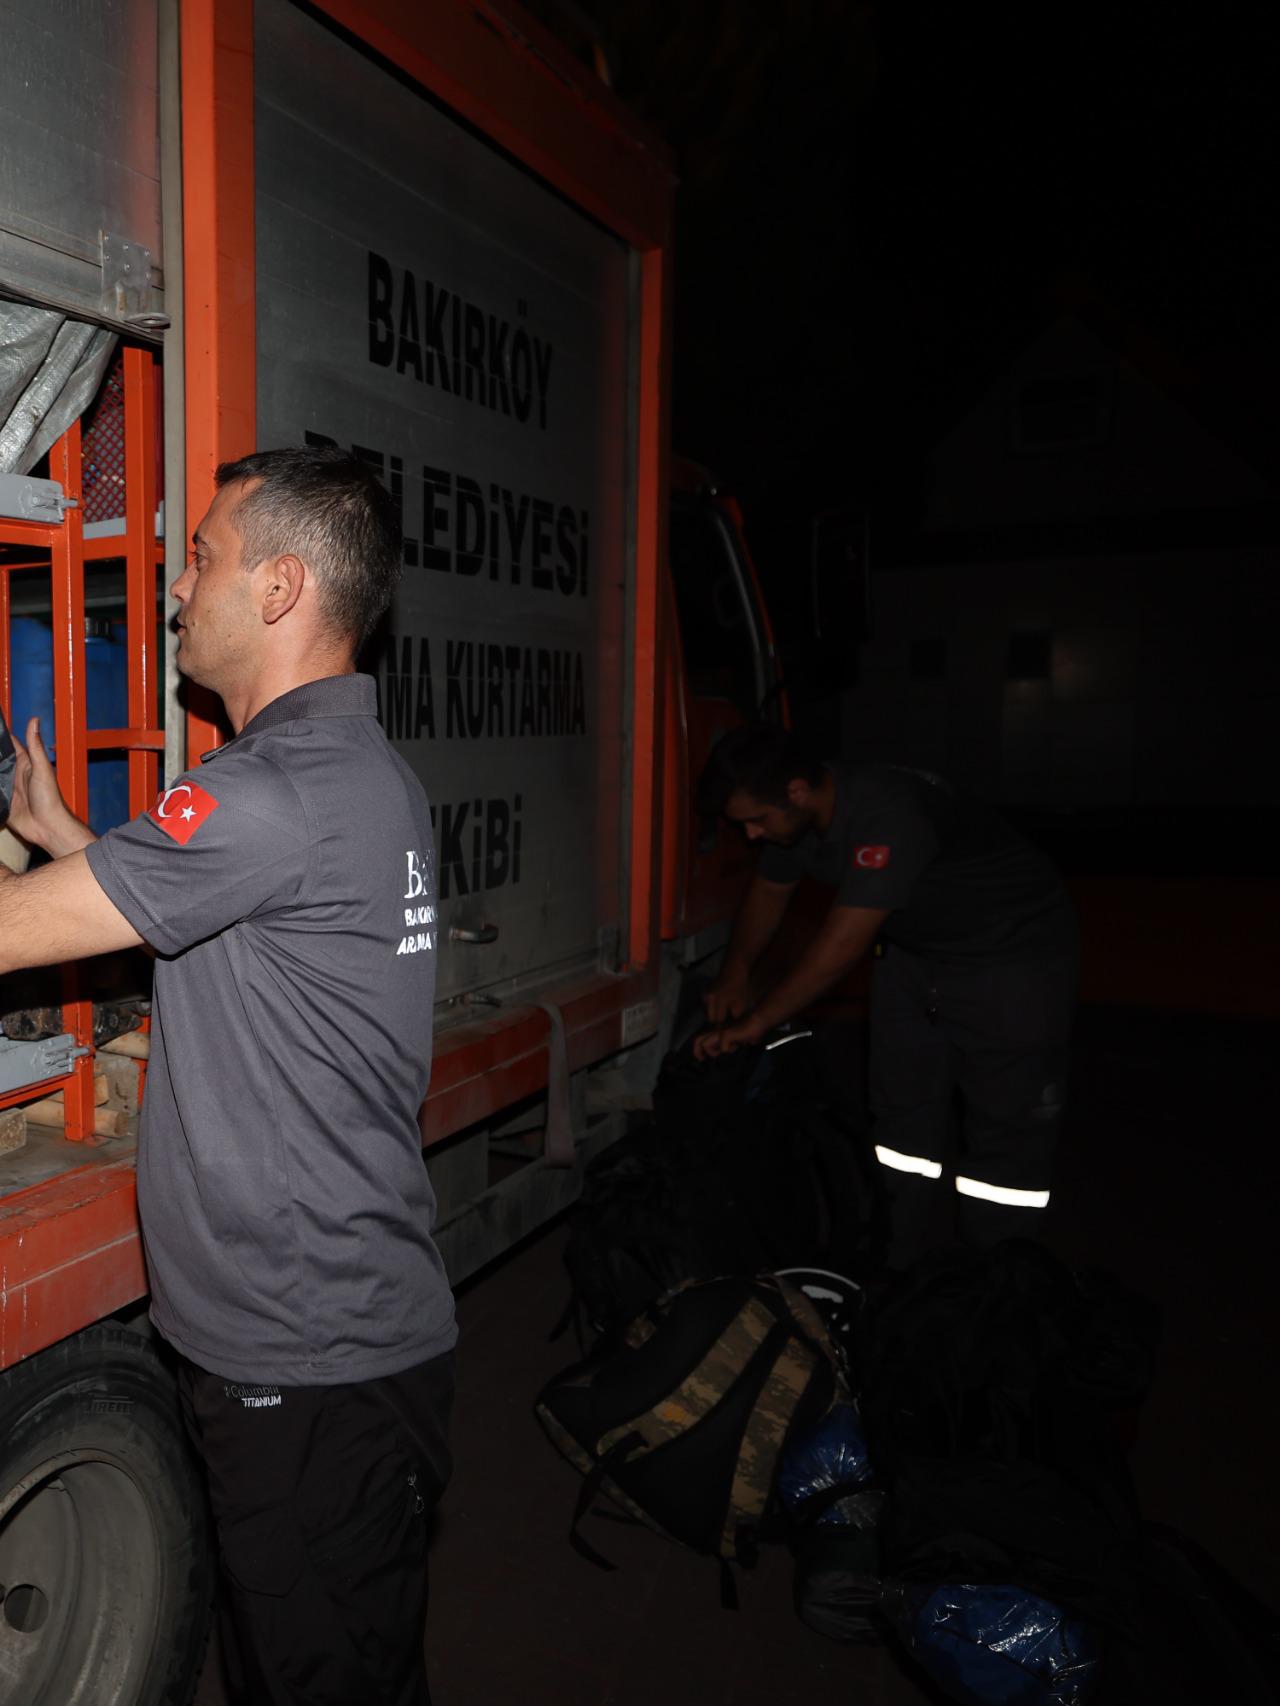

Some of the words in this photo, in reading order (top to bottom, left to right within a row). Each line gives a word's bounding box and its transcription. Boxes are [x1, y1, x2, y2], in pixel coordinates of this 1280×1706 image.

[368, 250, 552, 430] BAKIRKÖY
[446, 639, 586, 739] KURTARMA
[242, 1394, 282, 1408] TITANIUM
